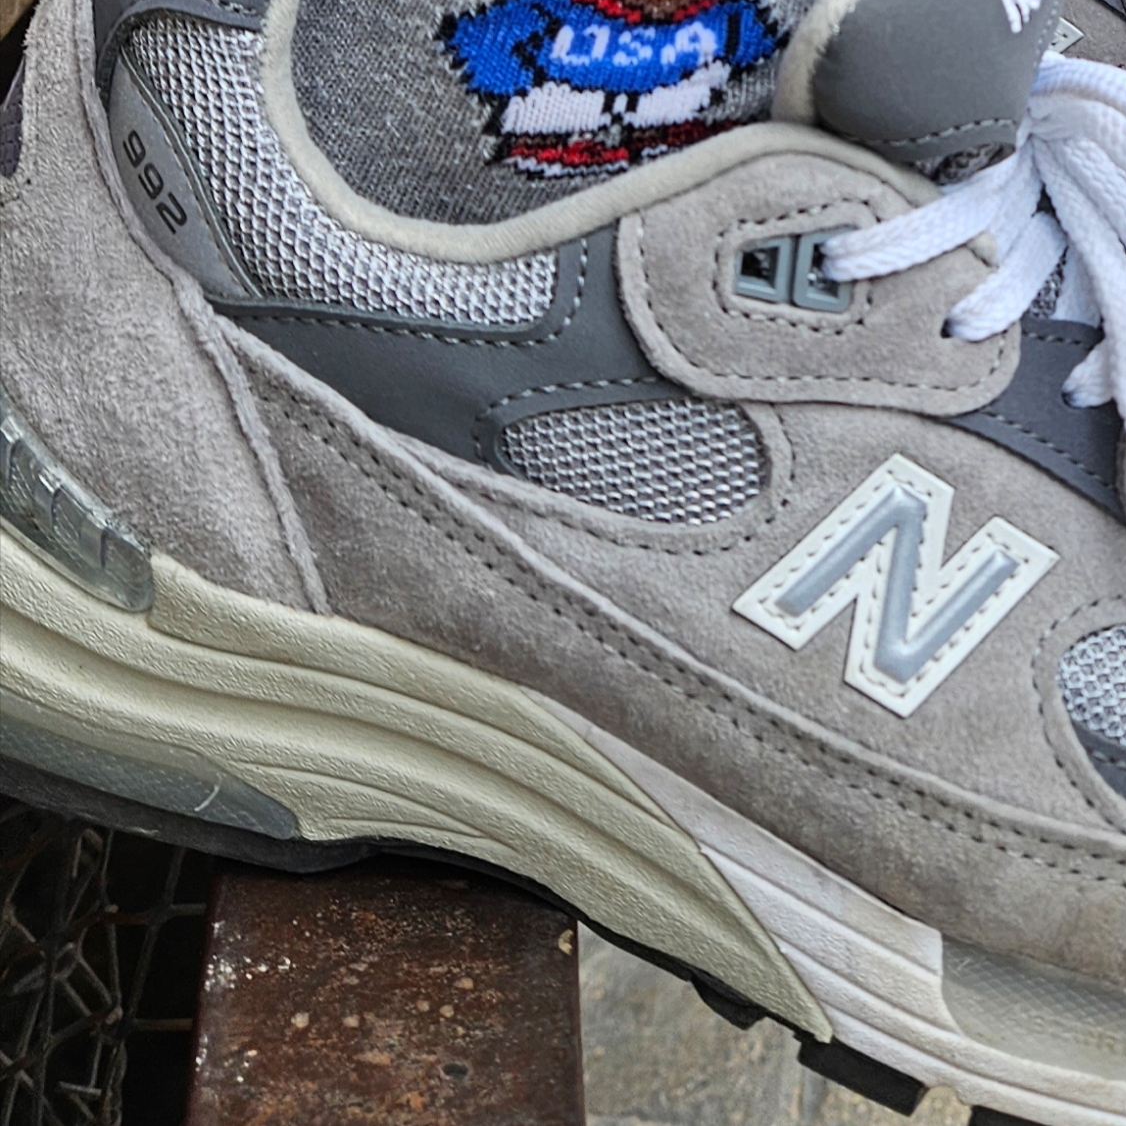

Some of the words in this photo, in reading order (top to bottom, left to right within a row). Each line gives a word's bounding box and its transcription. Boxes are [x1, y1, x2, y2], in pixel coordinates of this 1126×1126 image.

[550, 21, 718, 67] USA
[122, 129, 187, 235] 992
[731, 452, 1061, 718] N
